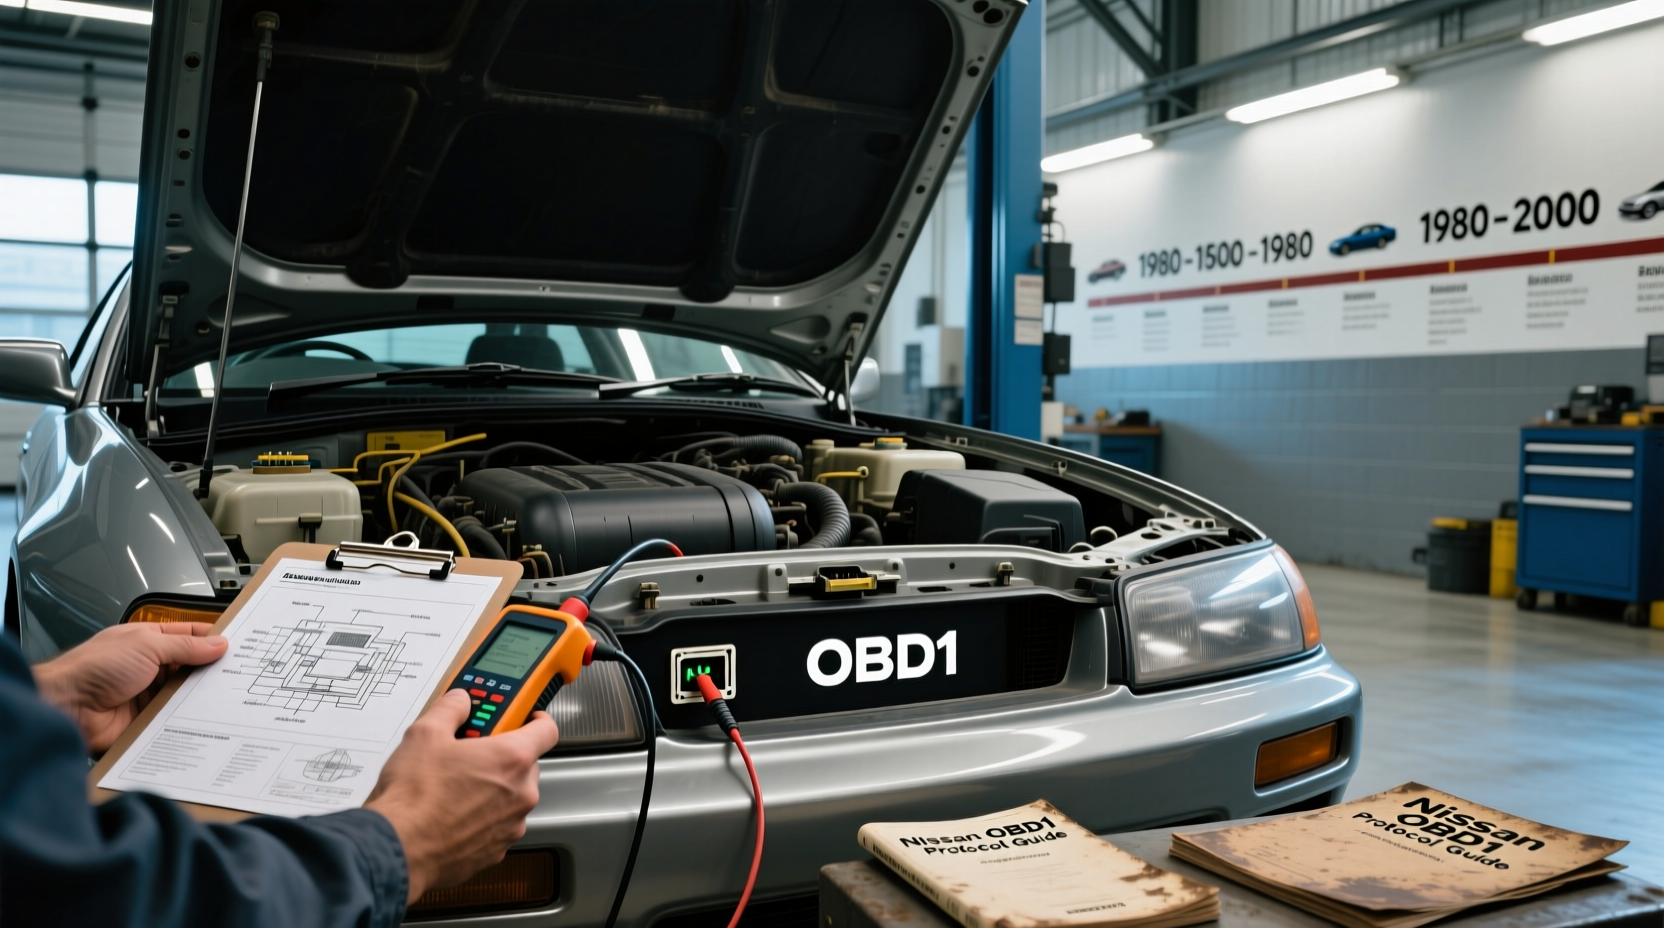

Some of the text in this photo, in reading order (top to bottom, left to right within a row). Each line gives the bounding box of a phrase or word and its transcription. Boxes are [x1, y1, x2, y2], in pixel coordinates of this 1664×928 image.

[1420, 189, 1600, 243] 1980-2000
[806, 629, 957, 687] OBD1
[899, 816, 1056, 848] Nissan OBD1
[923, 831, 1068, 855] Protocol Guide
[1352, 812, 1444, 847] Protocol
[1397, 814, 1503, 853] OBD1
[1402, 797, 1545, 851] Nissan
